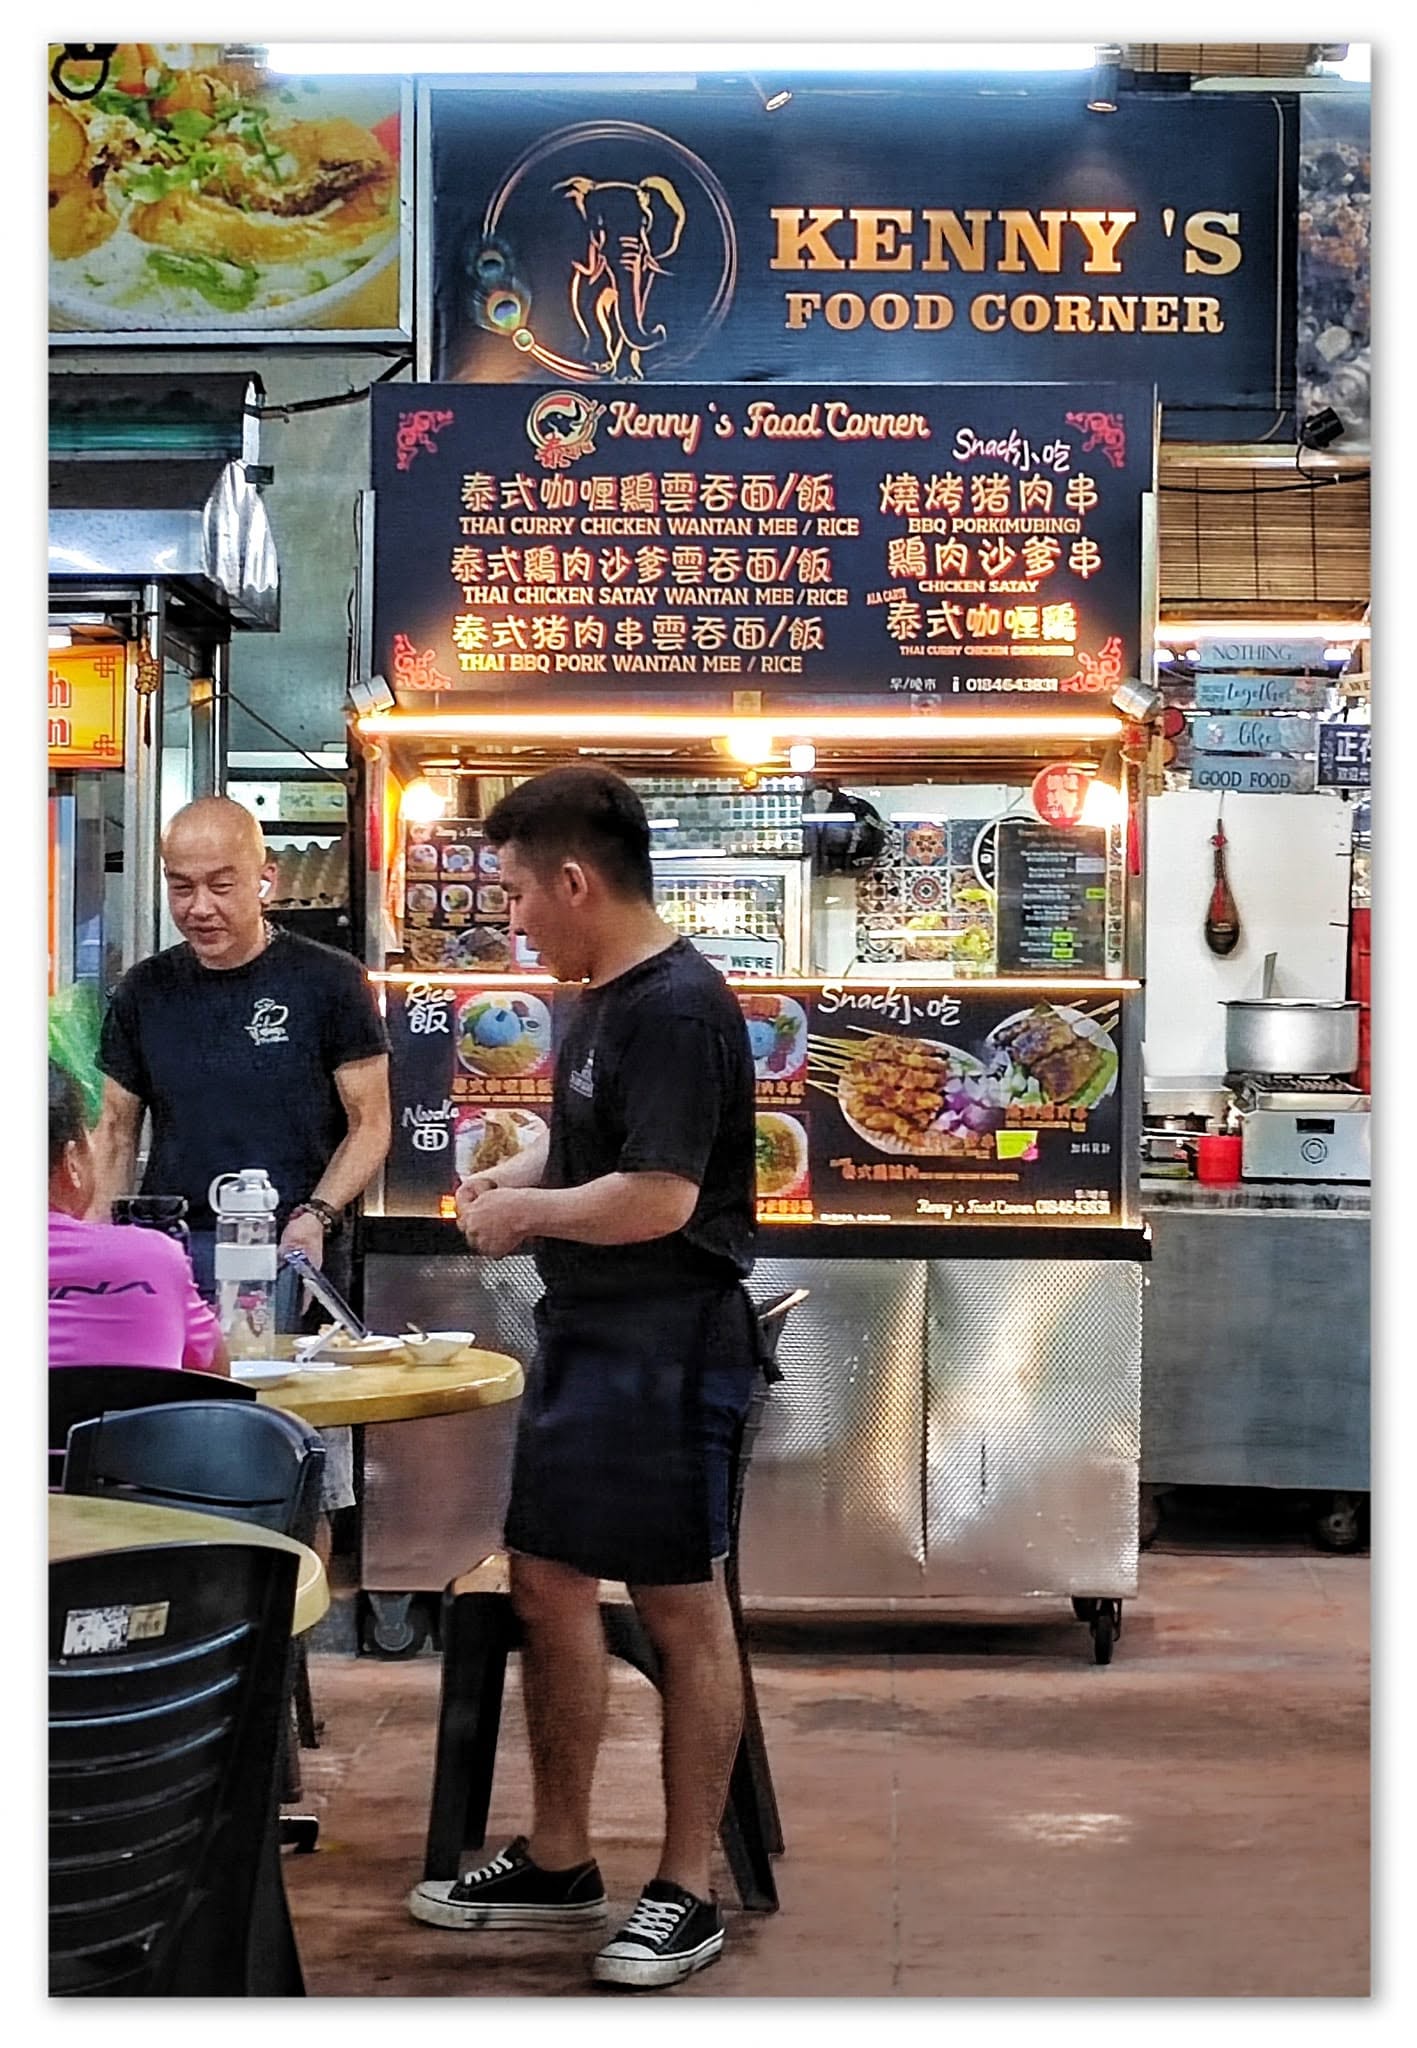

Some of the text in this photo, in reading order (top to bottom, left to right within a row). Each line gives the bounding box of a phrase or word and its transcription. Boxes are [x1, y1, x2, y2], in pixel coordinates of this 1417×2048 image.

[770, 208, 1243, 275] KENNY 'S
[785, 293, 1225, 333] FOOD CORNER
[607, 401, 702, 455] Kenny
[743, 401, 822, 439] Food
[826, 402, 931, 439] Corner
[952, 427, 1020, 466] Snack
[1012, 438, 1071, 472] 小吃
[459, 517, 505, 535] THAI
[510, 517, 576, 535] CURRY
[580, 517, 662, 536] CHICKEN
[667, 518, 753, 536] WANTAN
[757, 518, 798, 536] MEE
[816, 518, 860, 536] RICE
[908, 517, 947, 536] BBQ
[463, 586, 509, 605] THAI
[513, 586, 594, 605] CHICKEN
[598, 586, 659, 606] SATAY
[664, 587, 749, 606] WANTAN
[754, 587, 795, 606] MEE
[918, 580, 1039, 593] CHICKEN SATAY
[458, 653, 504, 672] THAI
[510, 654, 551, 673] BBQ
[554, 654, 608, 673] PORK
[612, 655, 697, 673] WANTAN
[702, 656, 742, 673] MEE
[761, 656, 803, 673] RICE
[899, 645, 925, 656] THAI
[1213, 645, 1292, 661] NOTHING
[1238, 721, 1275, 750] like
[1199, 770, 1291, 789] GOOD FOOD
[405, 982, 457, 1007] Rice
[818, 985, 901, 1019] Snack
[407, 1002, 449, 1034] 飯
[412, 1123, 449, 1151] 面
